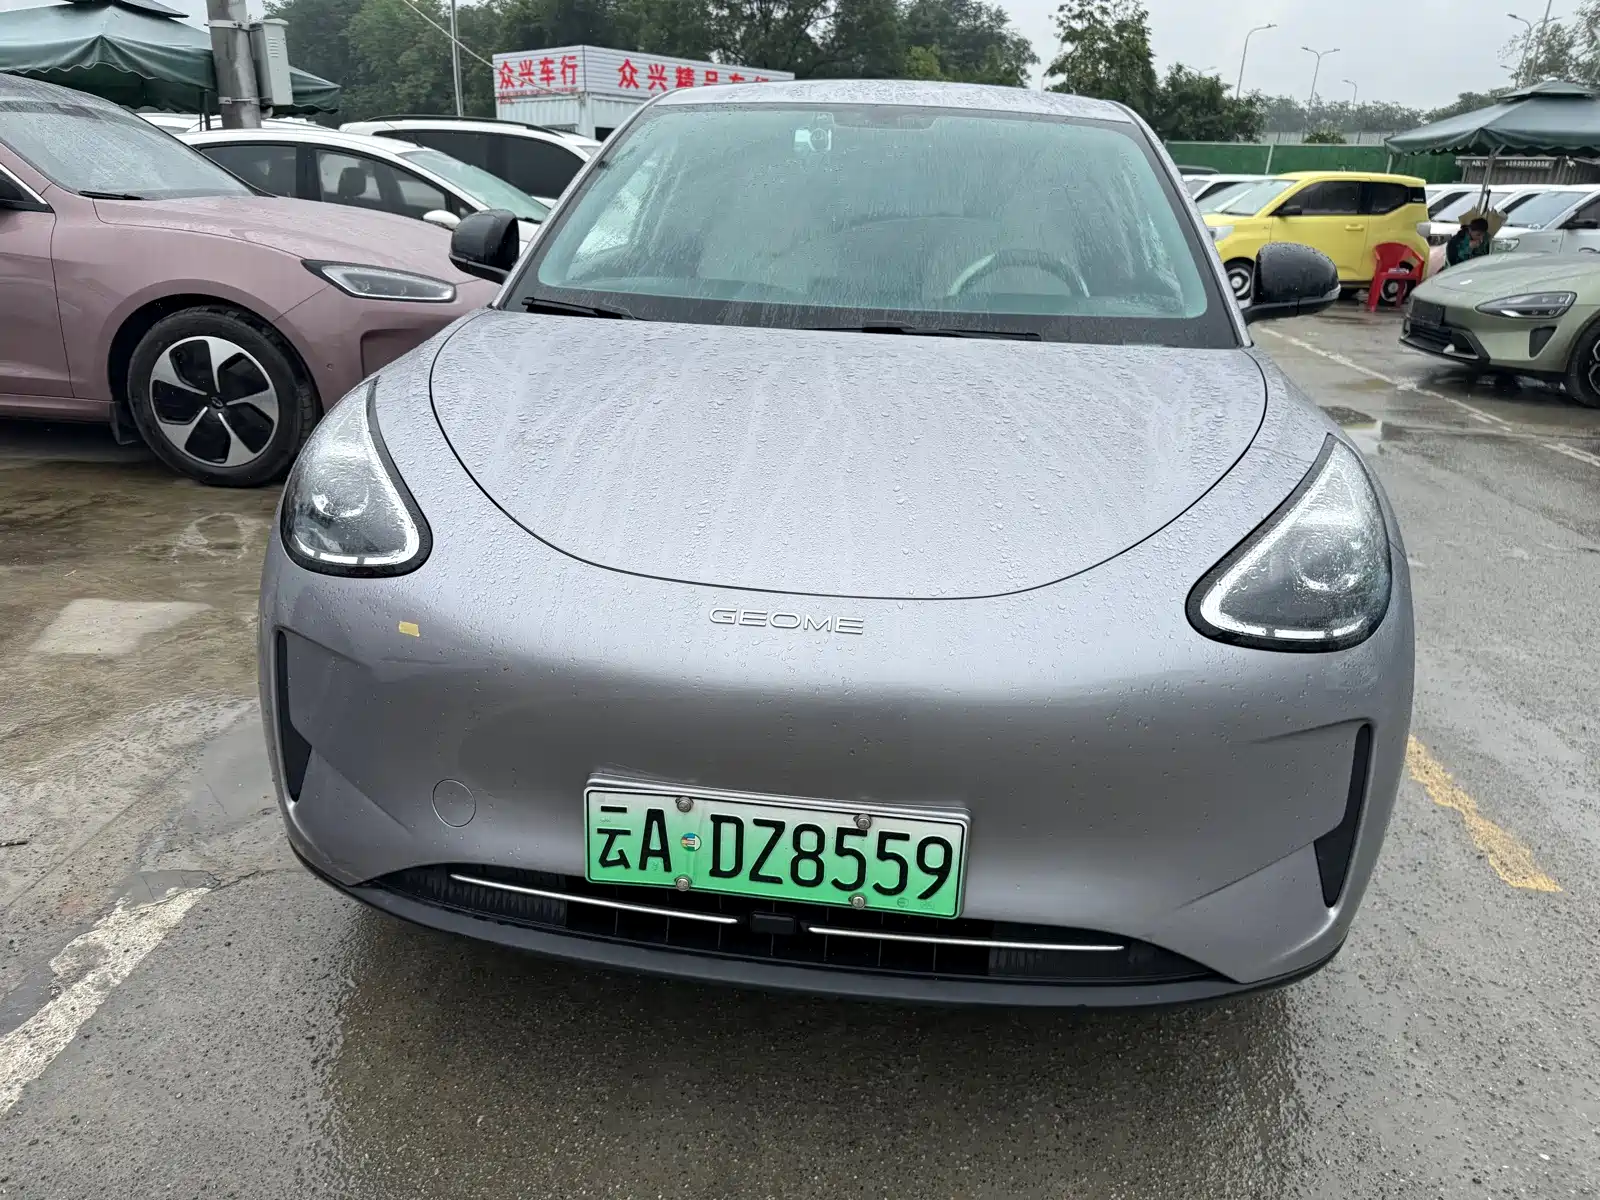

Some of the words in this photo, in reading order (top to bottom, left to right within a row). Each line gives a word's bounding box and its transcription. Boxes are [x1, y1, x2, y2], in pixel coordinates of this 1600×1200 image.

[499, 55, 578, 89] 众兴车行
[709, 607, 864, 635] GEOME
[709, 814, 953, 900] DZ8559
